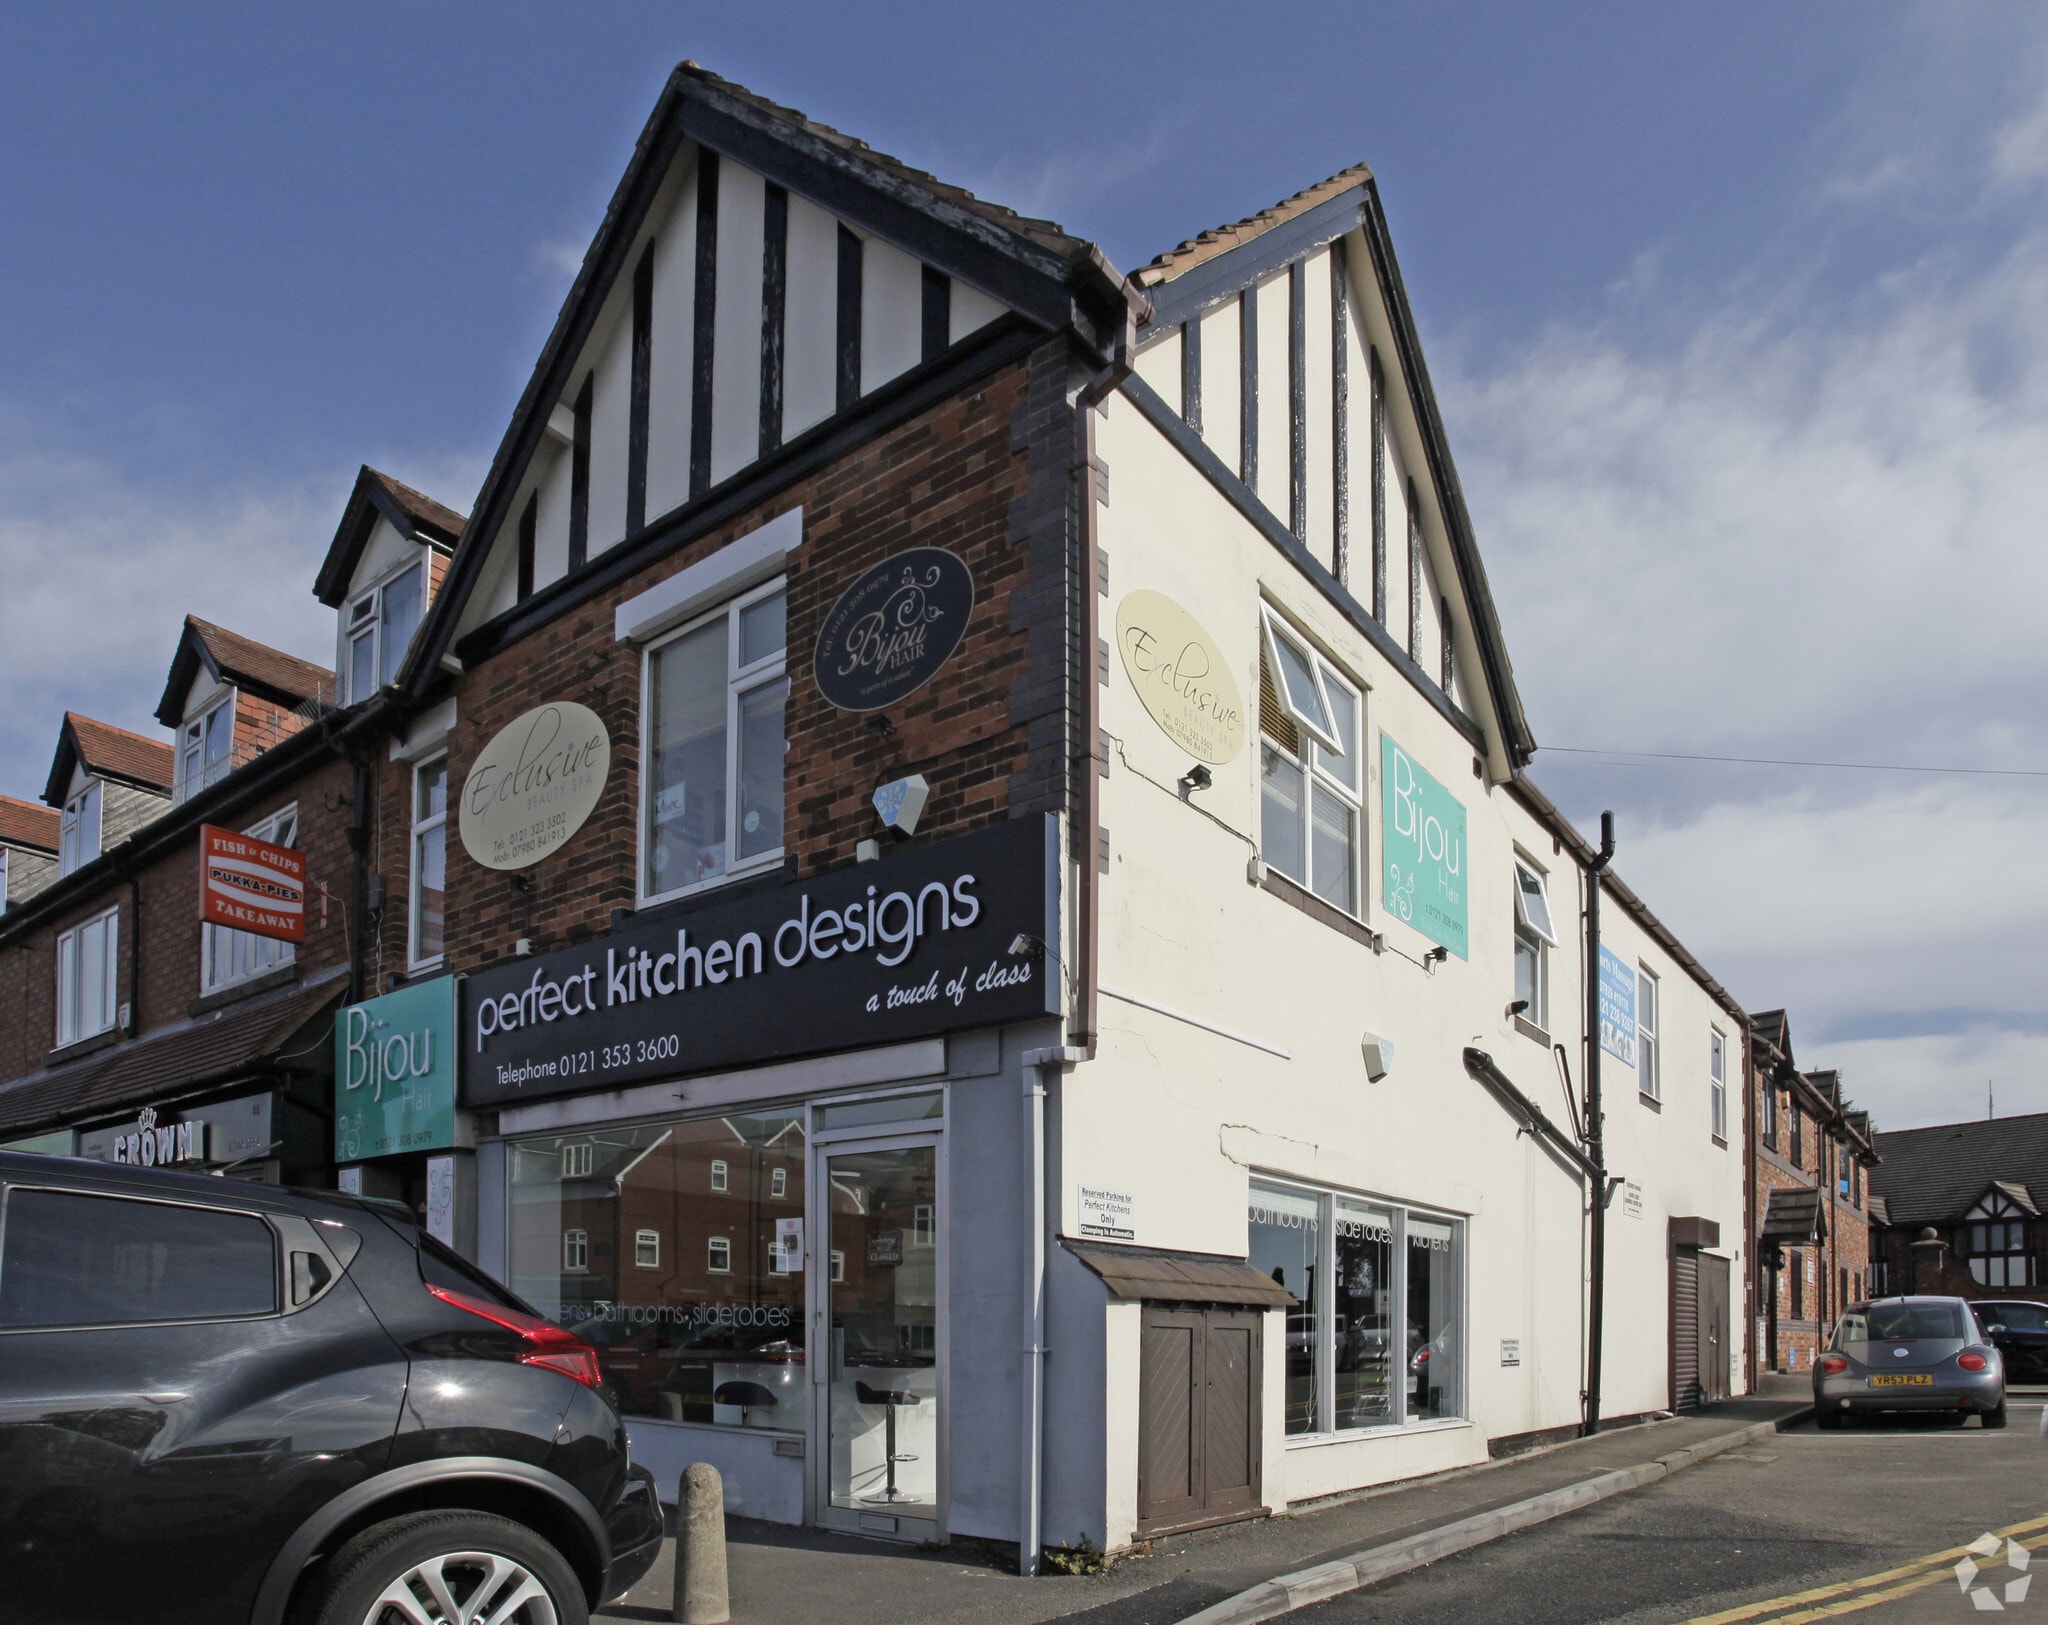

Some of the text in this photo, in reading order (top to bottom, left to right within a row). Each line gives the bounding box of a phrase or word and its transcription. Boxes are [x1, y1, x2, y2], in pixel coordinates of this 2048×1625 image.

[838, 611, 927, 676] Bijou
[890, 644, 925, 669] HAIR
[1126, 626, 1239, 731] Exclusive
[1174, 717, 1188, 731] 0121
[1189, 727, 1199, 741] 323
[1200, 734, 1214, 751] 3502
[1183, 706, 1233, 751] BEAUTY SPA
[464, 707, 606, 828] Exclusive
[527, 774, 593, 810] BEAUTY SPA
[510, 828, 527, 845] 0121
[531, 821, 545, 837] 323
[547, 811, 567, 829] 3502
[1394, 747, 1459, 877] Bijou
[213, 838, 300, 873] FISH & CHIPS
[512, 840, 536, 858] 07980
[537, 828, 566, 848] 841913
[212, 869, 299, 900] PUKKA-PIES
[1438, 867, 1460, 905] Hair
[477, 874, 980, 1052] perfect kitchen designs
[866, 960, 1032, 1012] a touch of class
[346, 1007, 430, 1102] Bijou
[497, 1034, 680, 1087] Telephone 0121 353 3600
[402, 1083, 433, 1112] Hair
[114, 1121, 193, 1167] CROWN
[398, 1133, 413, 1147] 308
[413, 1130, 433, 1145] 0979
[1084, 1199, 1131, 1214] Perfect Kitchens
[1101, 1213, 1115, 1226] Only
[870, 1252, 898, 1262] CLOSED
[594, 1301, 684, 1323] bathrooms
[693, 1301, 790, 1327] sliderobes
[1876, 1375, 1928, 1385] YR53 PLZ
